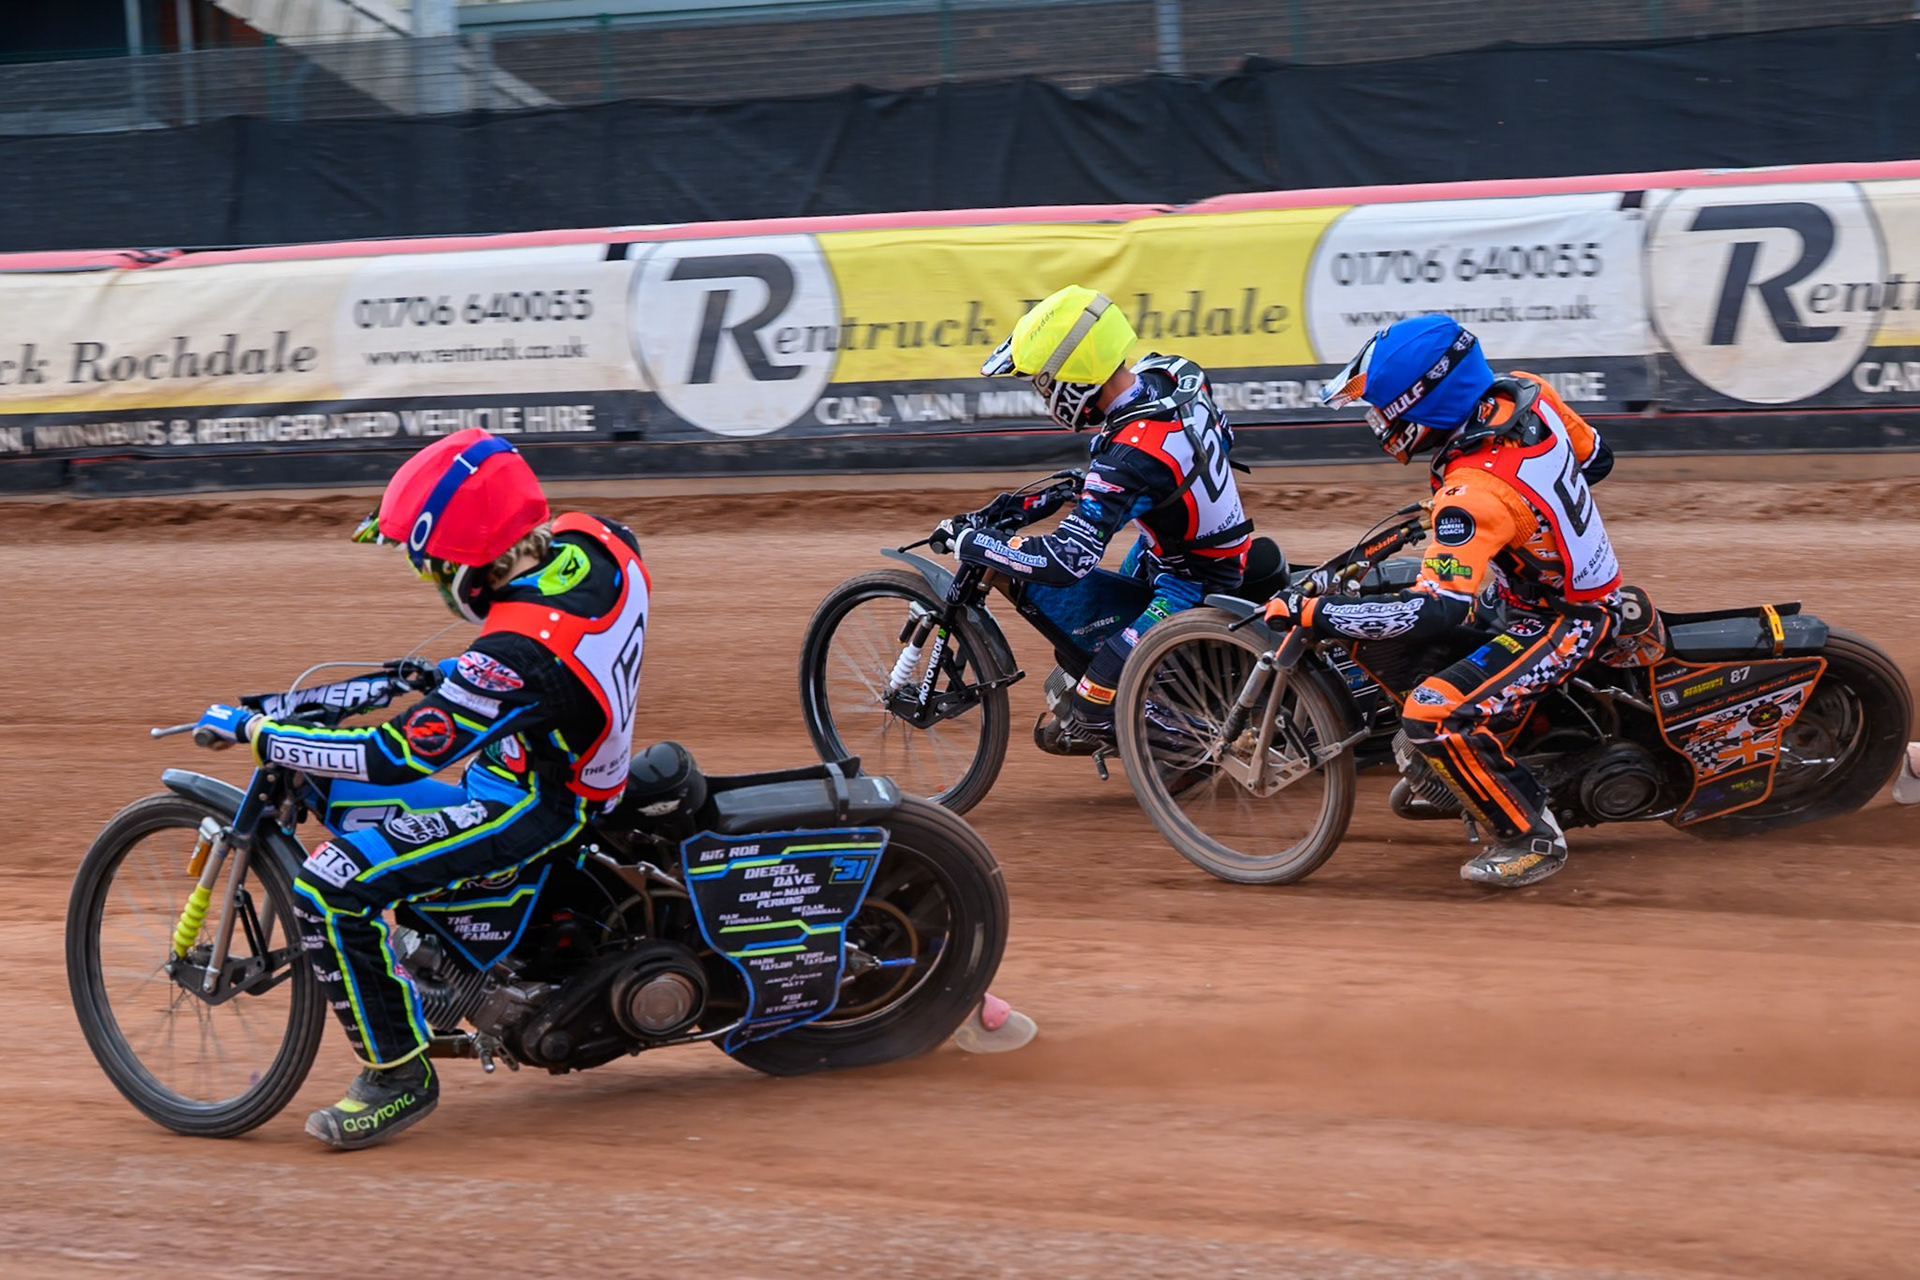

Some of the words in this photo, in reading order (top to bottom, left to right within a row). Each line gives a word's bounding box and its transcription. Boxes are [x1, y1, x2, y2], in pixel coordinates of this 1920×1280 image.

[1331, 249, 1446, 286] 01706
[1454, 242, 1603, 281] 640055
[354, 296, 455, 328] 01706
[461, 289, 593, 324] 640055
[66, 330, 318, 383] Rochdale
[1383, 382, 1426, 421] WULF
[168, 419, 196, 446] &
[523, 404, 597, 432] HIRE
[1573, 567, 1589, 584] THE
[918, 636, 945, 706] MOTOVERDE
[1729, 665, 1751, 684] 87
[273, 747, 354, 770] DSTILL
[315, 846, 356, 878] FTS
[744, 864, 799, 880] DIESEL
[772, 873, 816, 888] DAVE
[756, 895, 804, 910] PERKINS
[447, 916, 473, 926] THE
[454, 922, 490, 934] REED
[462, 930, 511, 942] FAMILY
